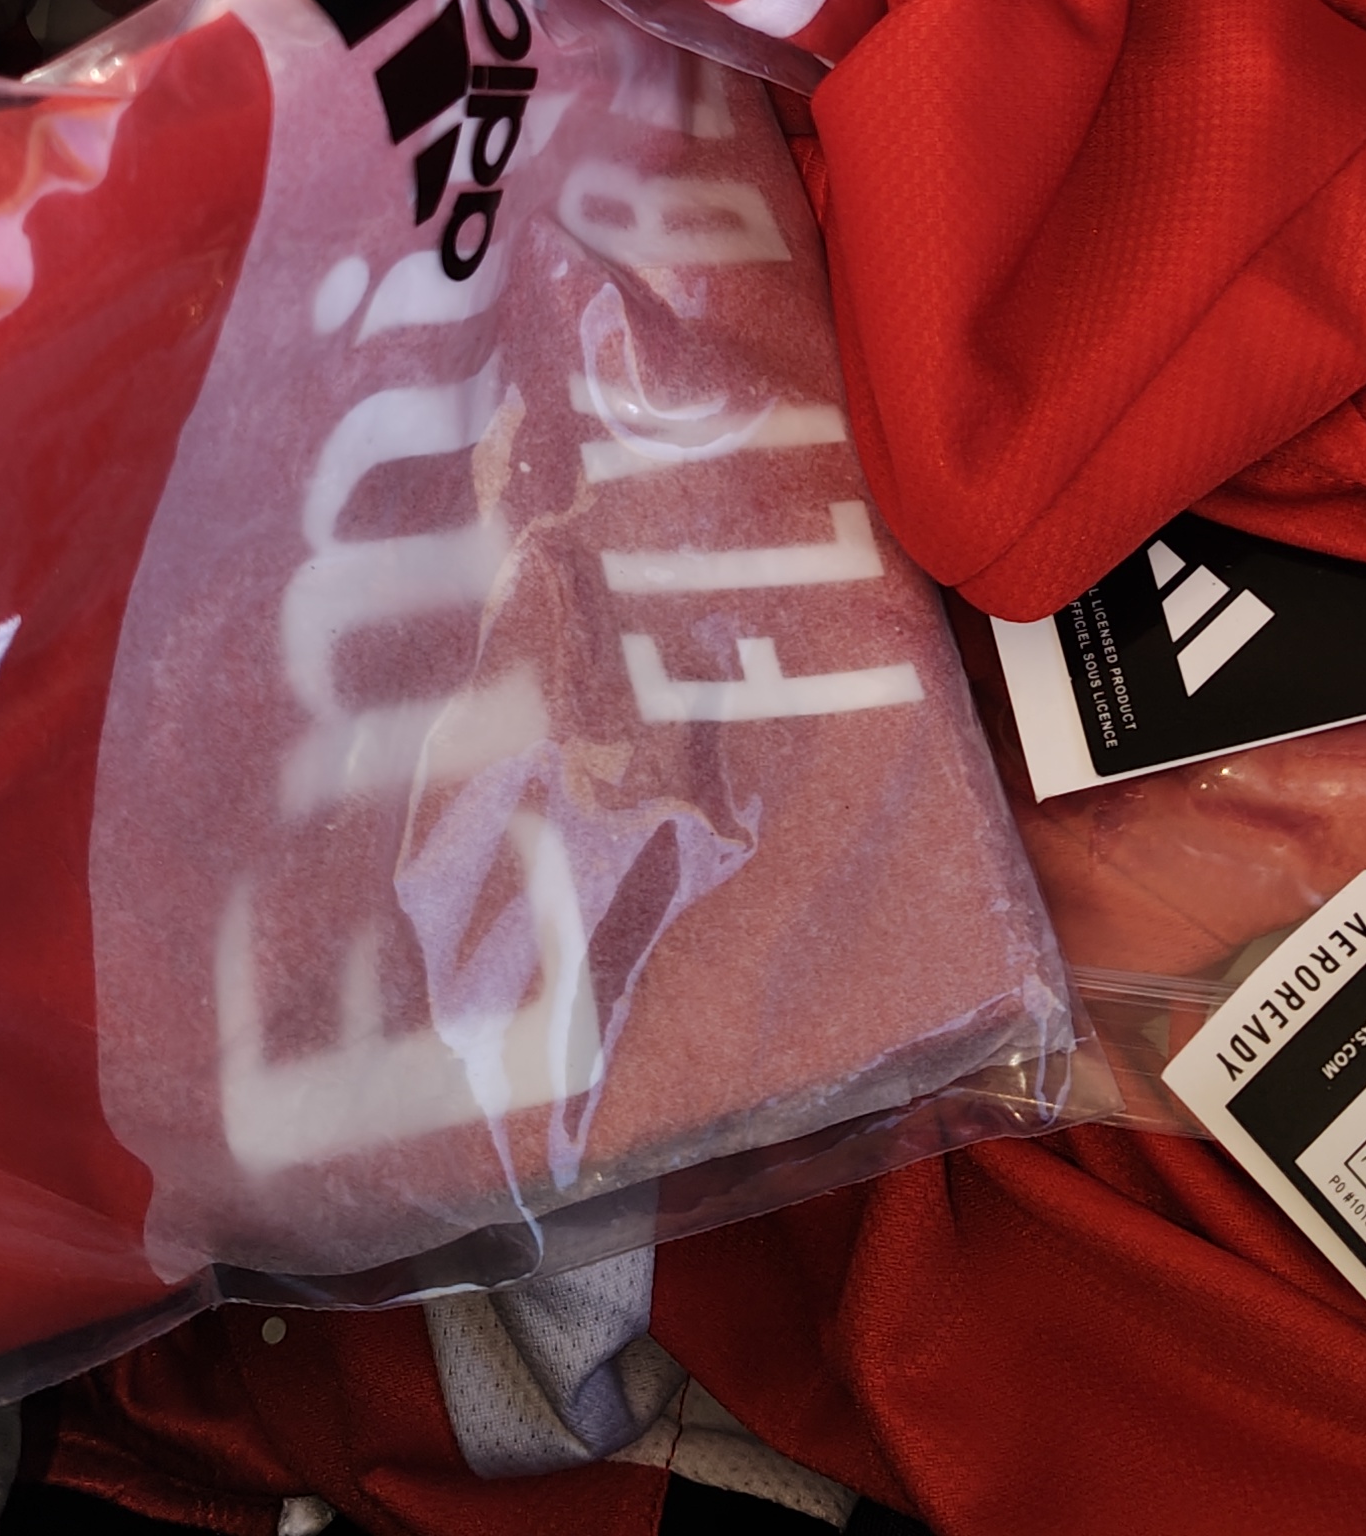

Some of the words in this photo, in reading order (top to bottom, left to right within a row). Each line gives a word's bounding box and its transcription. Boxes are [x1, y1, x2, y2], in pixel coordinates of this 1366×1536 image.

[1067, 600, 1092, 649] FFICIEL
[1081, 652, 1102, 688] SOUS
[1089, 599, 1119, 664] LICENSED
[1108, 666, 1137, 731] PRODUCT
[1091, 690, 1118, 749] LICENCE
